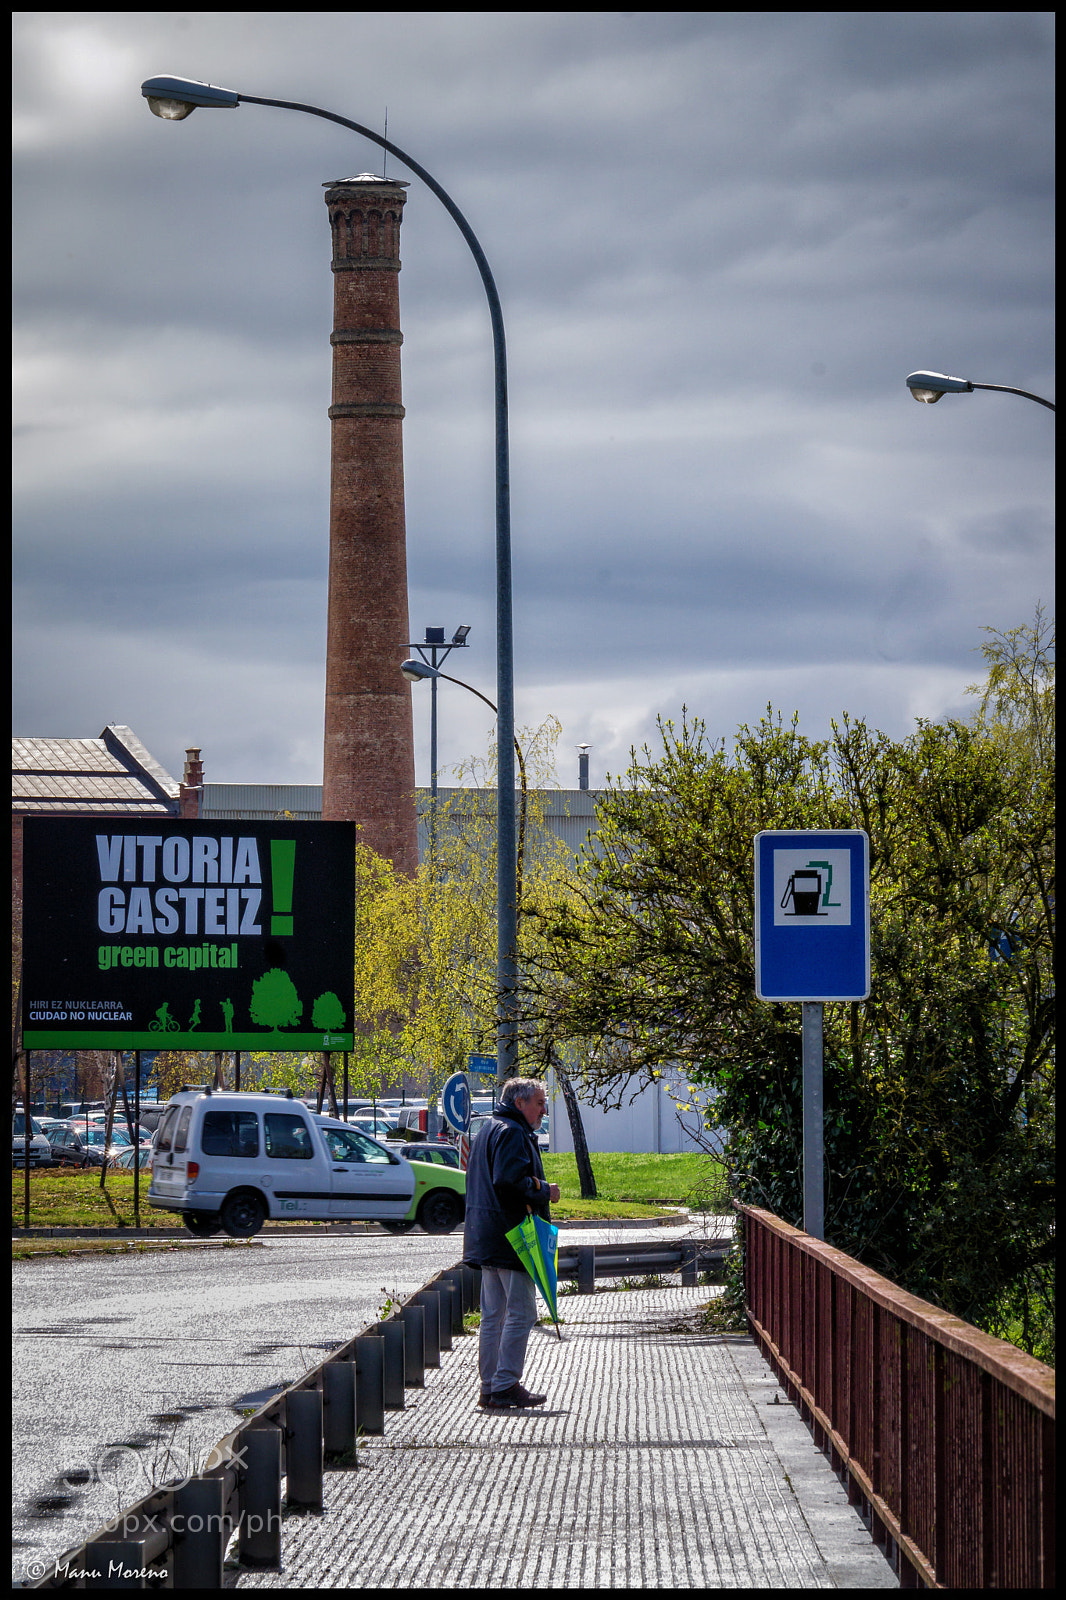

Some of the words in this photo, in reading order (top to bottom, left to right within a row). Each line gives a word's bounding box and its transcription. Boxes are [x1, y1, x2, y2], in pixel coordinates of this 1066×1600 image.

[95, 834, 262, 884] VITORIA
[97, 886, 262, 936] GASTEIZ
[98, 945, 159, 971] green
[163, 942, 238, 971] capital
[29, 1000, 49, 1010] HIRI
[52, 1000, 63, 1010] EZ
[65, 1000, 124, 1011] NUKLEARRA
[29, 1011, 68, 1021] CIUDAD
[69, 1011, 86, 1021] NO
[87, 1011, 133, 1022] NUCLEAR
